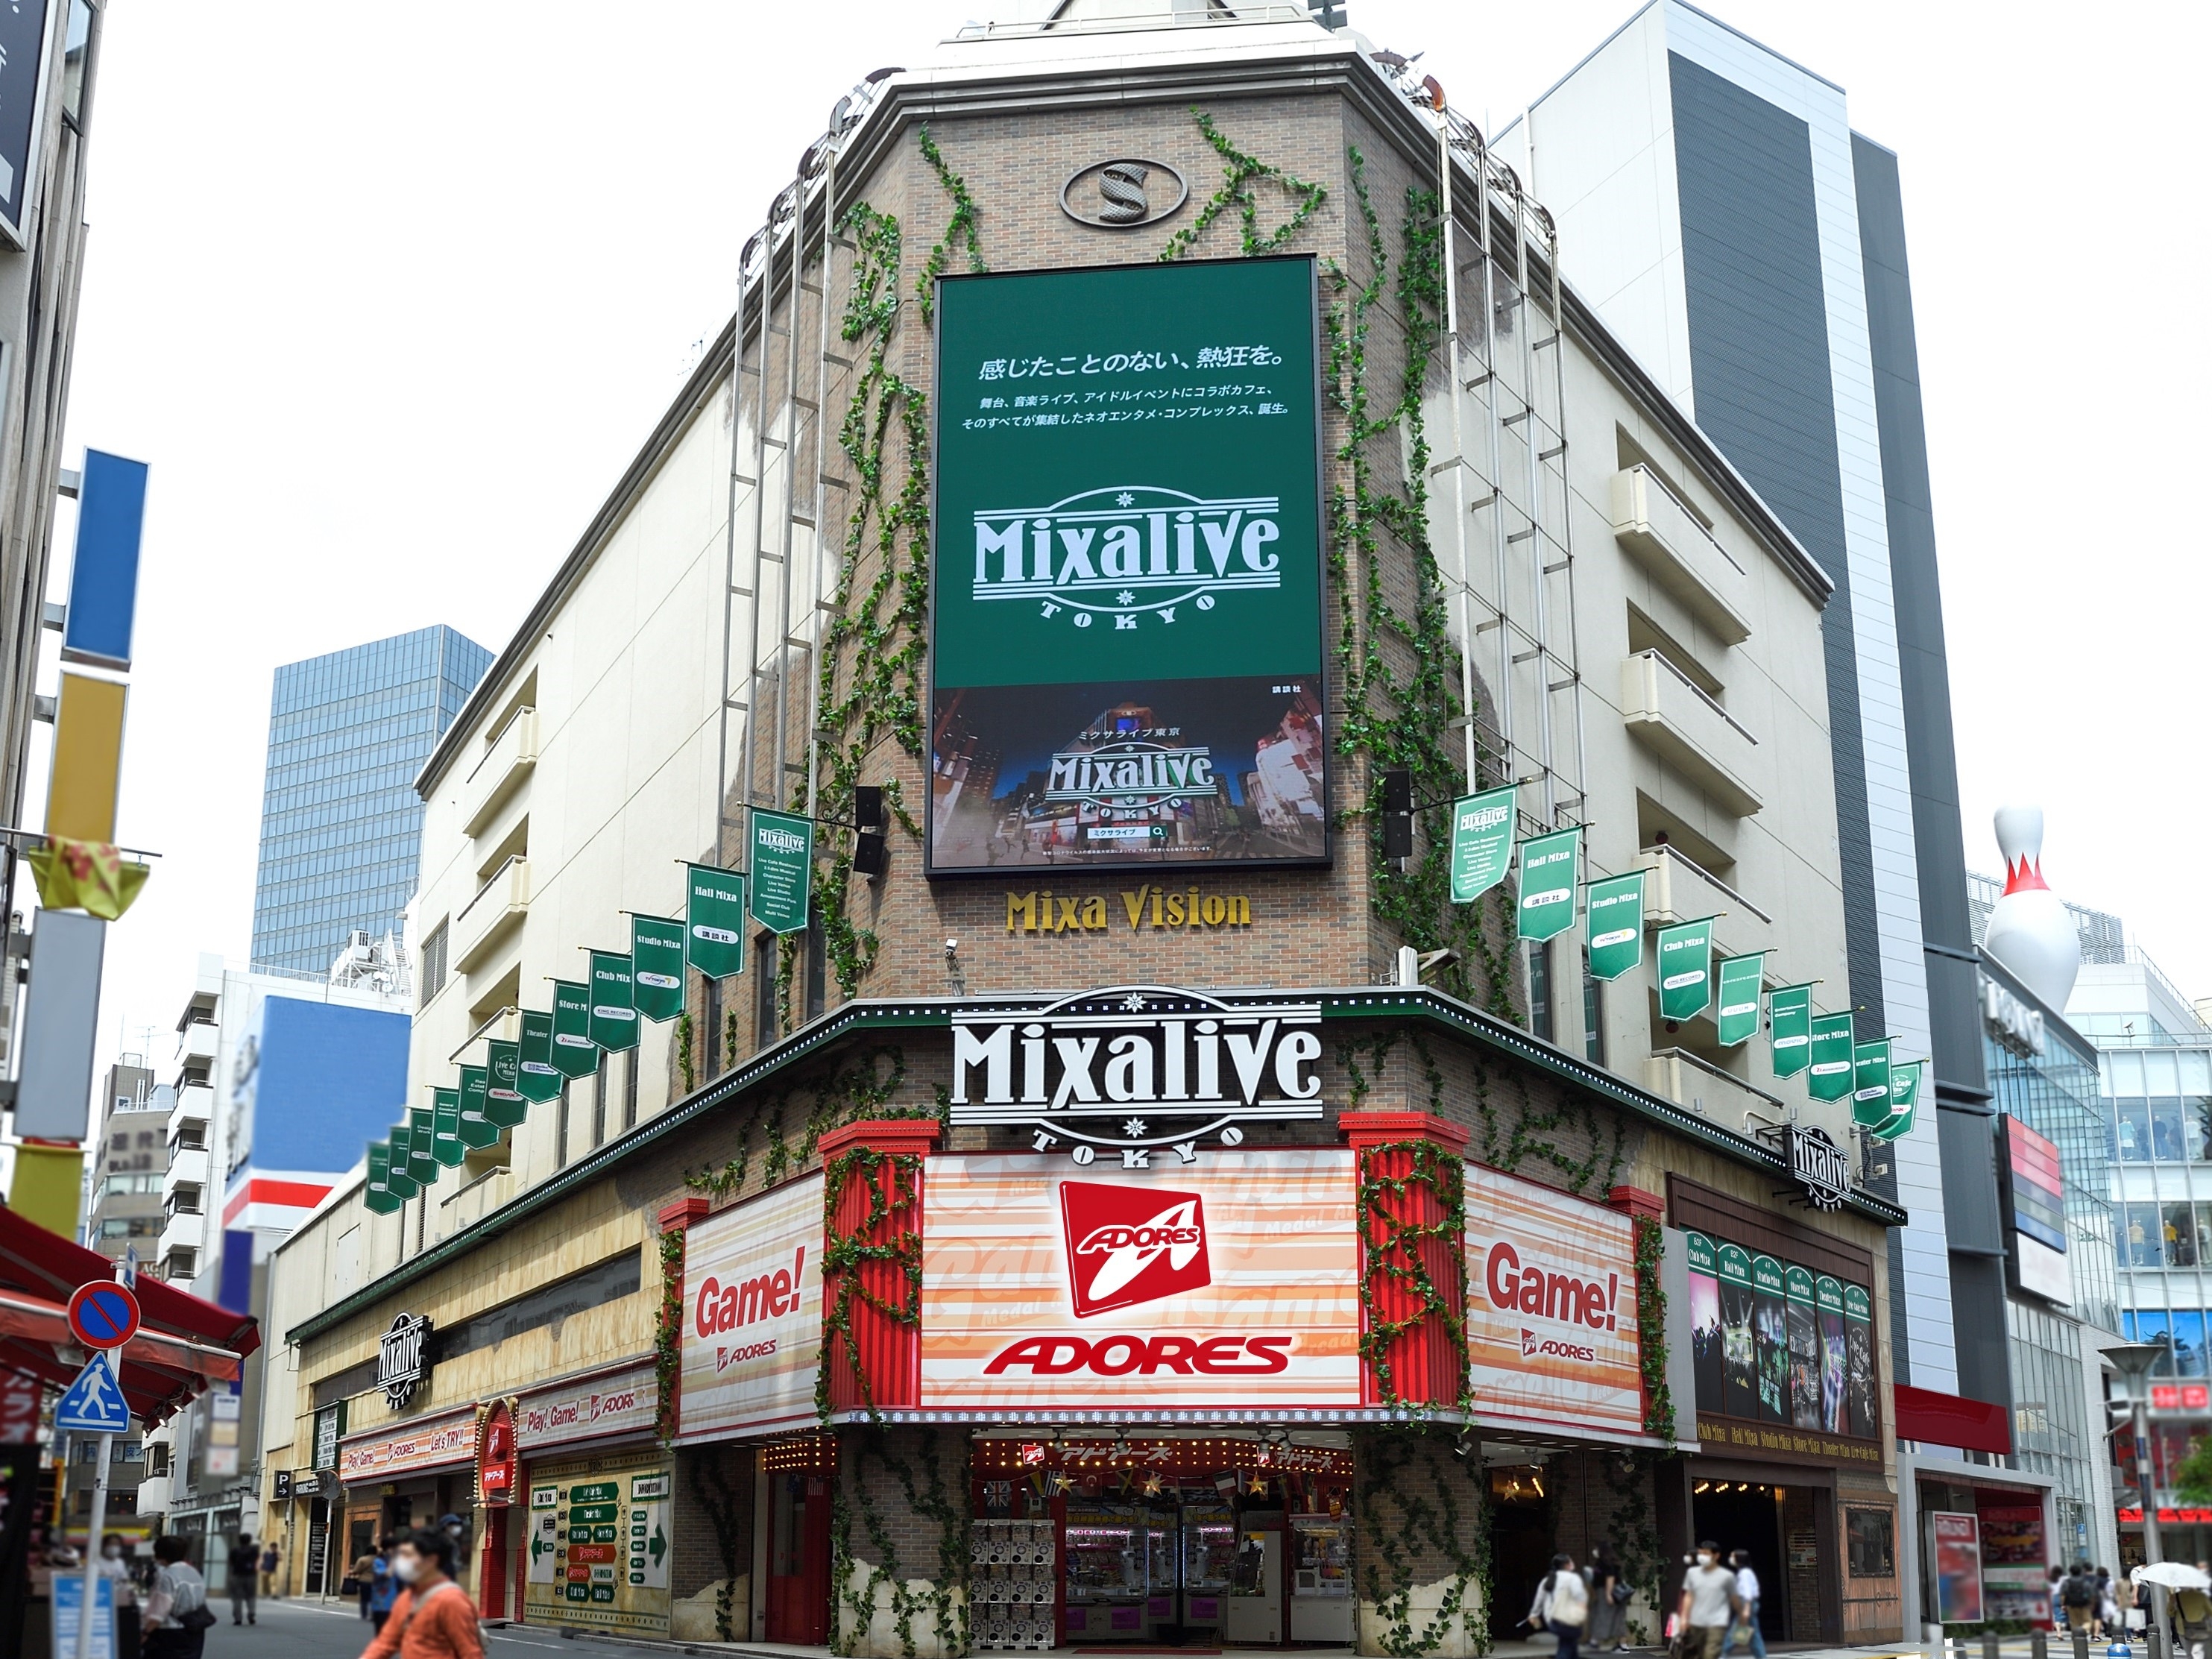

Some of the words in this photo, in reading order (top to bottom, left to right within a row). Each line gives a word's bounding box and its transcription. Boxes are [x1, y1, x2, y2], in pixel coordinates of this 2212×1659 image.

[978, 344, 1283, 380] 感じたことのない、熱狂を。
[980, 384, 1273, 409] 舞台、音楽ライブ、アイドルイベントにコラボカフェ、
[962, 402, 1288, 429] そのすべてが集結したネオエンタメ・コンプレックス、誕生。
[973, 509, 1279, 585] Mixalive
[1040, 595, 1215, 629] TOKYO
[1272, 684, 1301, 693] 講談社
[1078, 727, 1180, 740] ミクサライブ東京
[1047, 753, 1214, 793] Mixalive
[1083, 799, 1182, 819] TOKYO
[759, 829, 804, 850] Mixalive
[1094, 828, 1135, 837] ミクサライブ
[1527, 857, 1545, 869] Hall
[1547, 850, 1570, 863] Mixa
[695, 886, 713, 898] Hall
[716, 890, 737, 902] Mixa
[1592, 897, 1617, 909] Studio
[1619, 893, 1638, 903] Mixa
[1006, 890, 1107, 932] Mixa
[1121, 884, 1251, 931] Vision
[637, 935, 661, 946] Studio
[663, 939, 681, 949] Mixa
[1663, 942, 1683, 952] Club
[1685, 937, 1705, 948] Mixa
[596, 970, 614, 980] Club
[616, 973, 631, 983] Mix
[558, 999, 579, 1010] Store
[526, 1029, 548, 1038] Theater
[1831, 1030, 1850, 1039] Mixa
[951, 1019, 1322, 1109] Mixalive
[1032, 1127, 1243, 1168] TOKYO
[1792, 1130, 1851, 1194] Mixalive
[1077, 1225, 1200, 1255] ADORES
[1689, 1249, 1699, 1262] Club
[1700, 1252, 1711, 1266] Mixa
[1724, 1260, 1734, 1274] Hall
[1734, 1264, 1745, 1276] Mixa
[1487, 1242, 1618, 1331] Game!
[1756, 1271, 1770, 1284] Studio
[1771, 1274, 1780, 1287] Mixa
[1800, 1283, 1810, 1296] Mixa
[696, 1245, 805, 1338] Game!
[378, 1326, 422, 1381] Mixalive
[729, 1339, 776, 1364] ADORES
[983, 1337, 1291, 1376] ADORES
[1540, 1340, 1594, 1361] ADORES
[1850, 1334, 1859, 1355] Live
[1859, 1347, 1870, 1367] Cafe
[1854, 1356, 1864, 1373] Mixa
[527, 1408, 548, 1432] Play!
[550, 1401, 579, 1426] Game!
[394, 1442, 415, 1455] ADORES
[431, 1432, 446, 1451] Let's
[447, 1429, 464, 1447] TRY!!
[1698, 1423, 1712, 1440] Club
[1712, 1424, 1726, 1442] Mixa
[1731, 1427, 1744, 1444] Hall
[1745, 1429, 1758, 1446] Mixa
[1760, 1431, 1778, 1449] Studio
[1779, 1433, 1792, 1450] Mixa
[1793, 1435, 1807, 1452] Store
[1808, 1438, 1821, 1455] Mixa
[1822, 1441, 1838, 1456] Theater
[1839, 1443, 1850, 1458] Mixa
[1851, 1446, 1859, 1458] Live
[1869, 1447, 1879, 1461] Mixa
[1061, 1447, 1173, 1461] アドアーズ
[279, 1475, 289, 1485] P
[485, 1470, 505, 1482] アドアーズ
